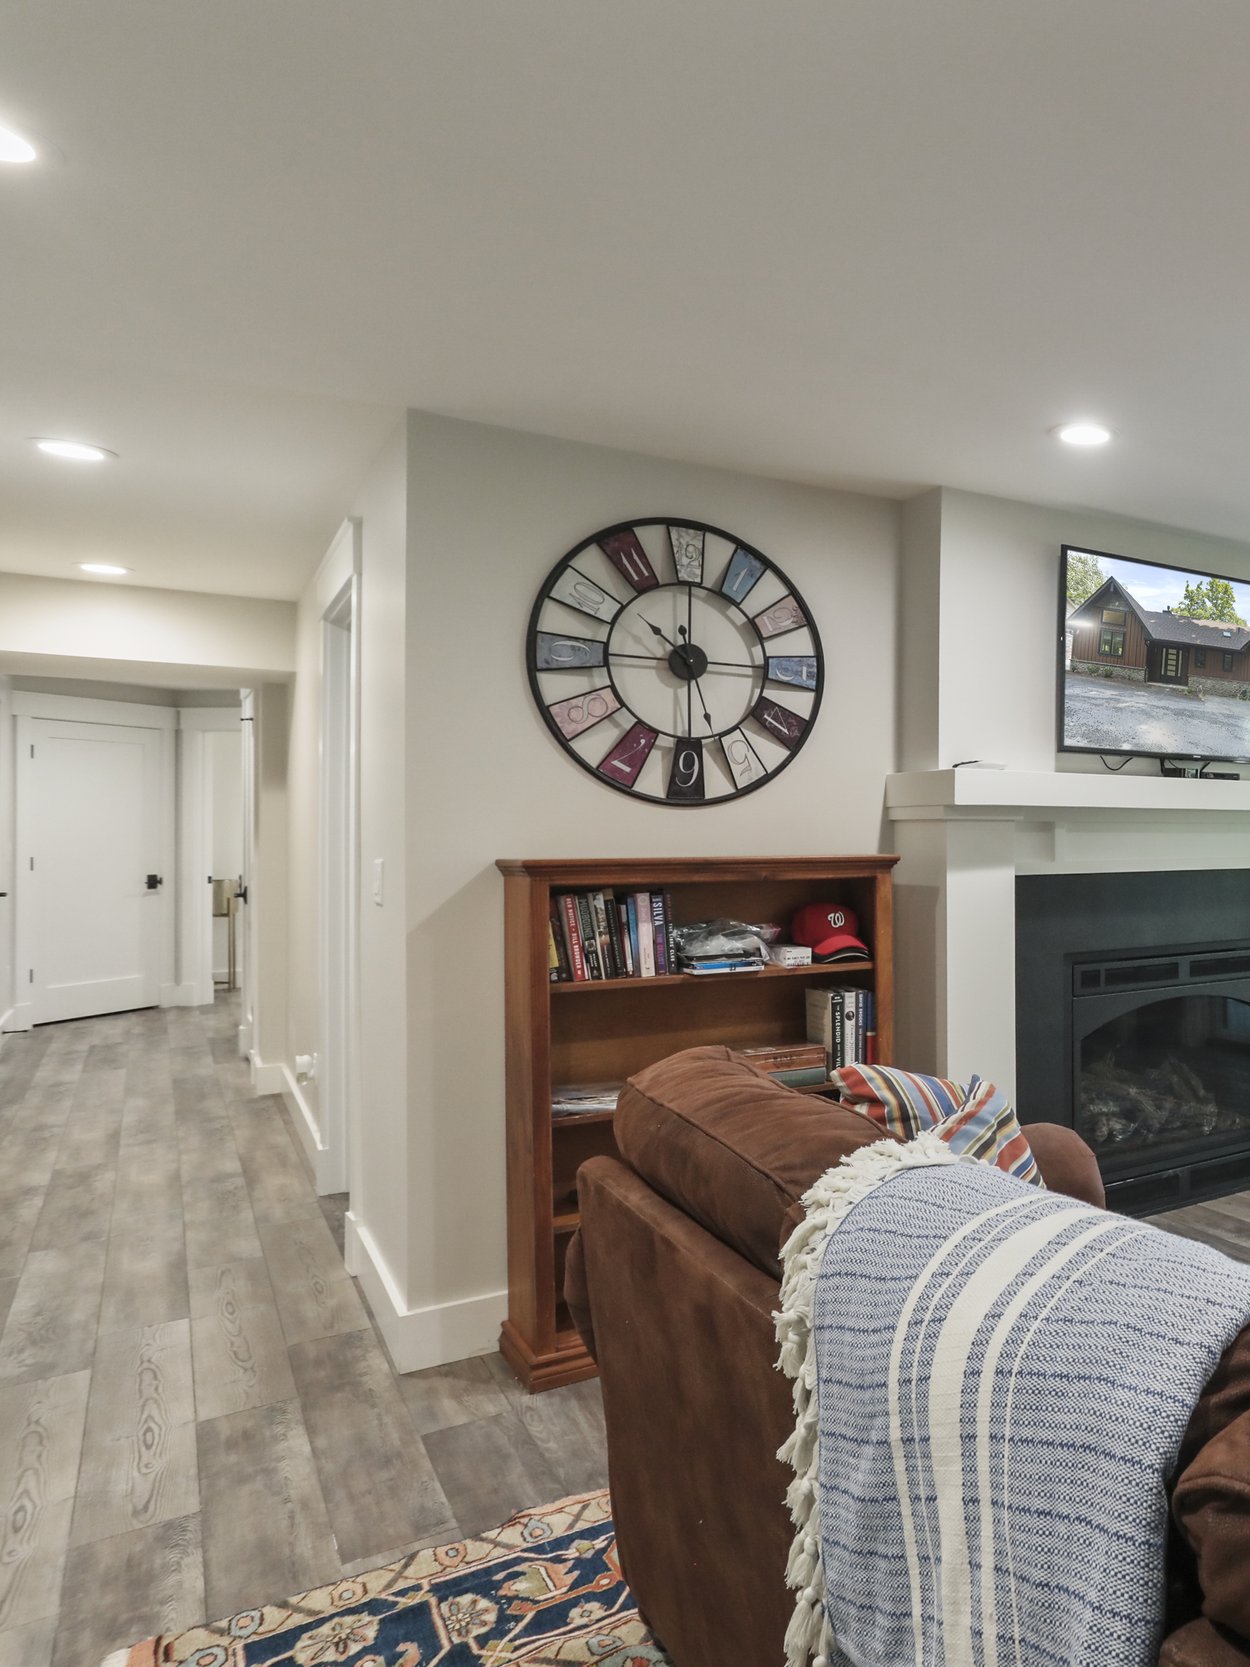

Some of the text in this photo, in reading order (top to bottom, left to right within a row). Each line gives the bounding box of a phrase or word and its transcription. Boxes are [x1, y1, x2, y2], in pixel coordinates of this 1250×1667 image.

[620, 548, 649, 582] 11
[676, 543, 702, 570] 12
[732, 567, 748, 592] 1
[568, 582, 606, 614] 10
[568, 694, 608, 724] 8
[763, 706, 789, 734] 4
[611, 738, 646, 773] 7
[727, 740, 753, 777] 5
[652, 902, 664, 926] SILVA
[828, 911, 844, 928] W
